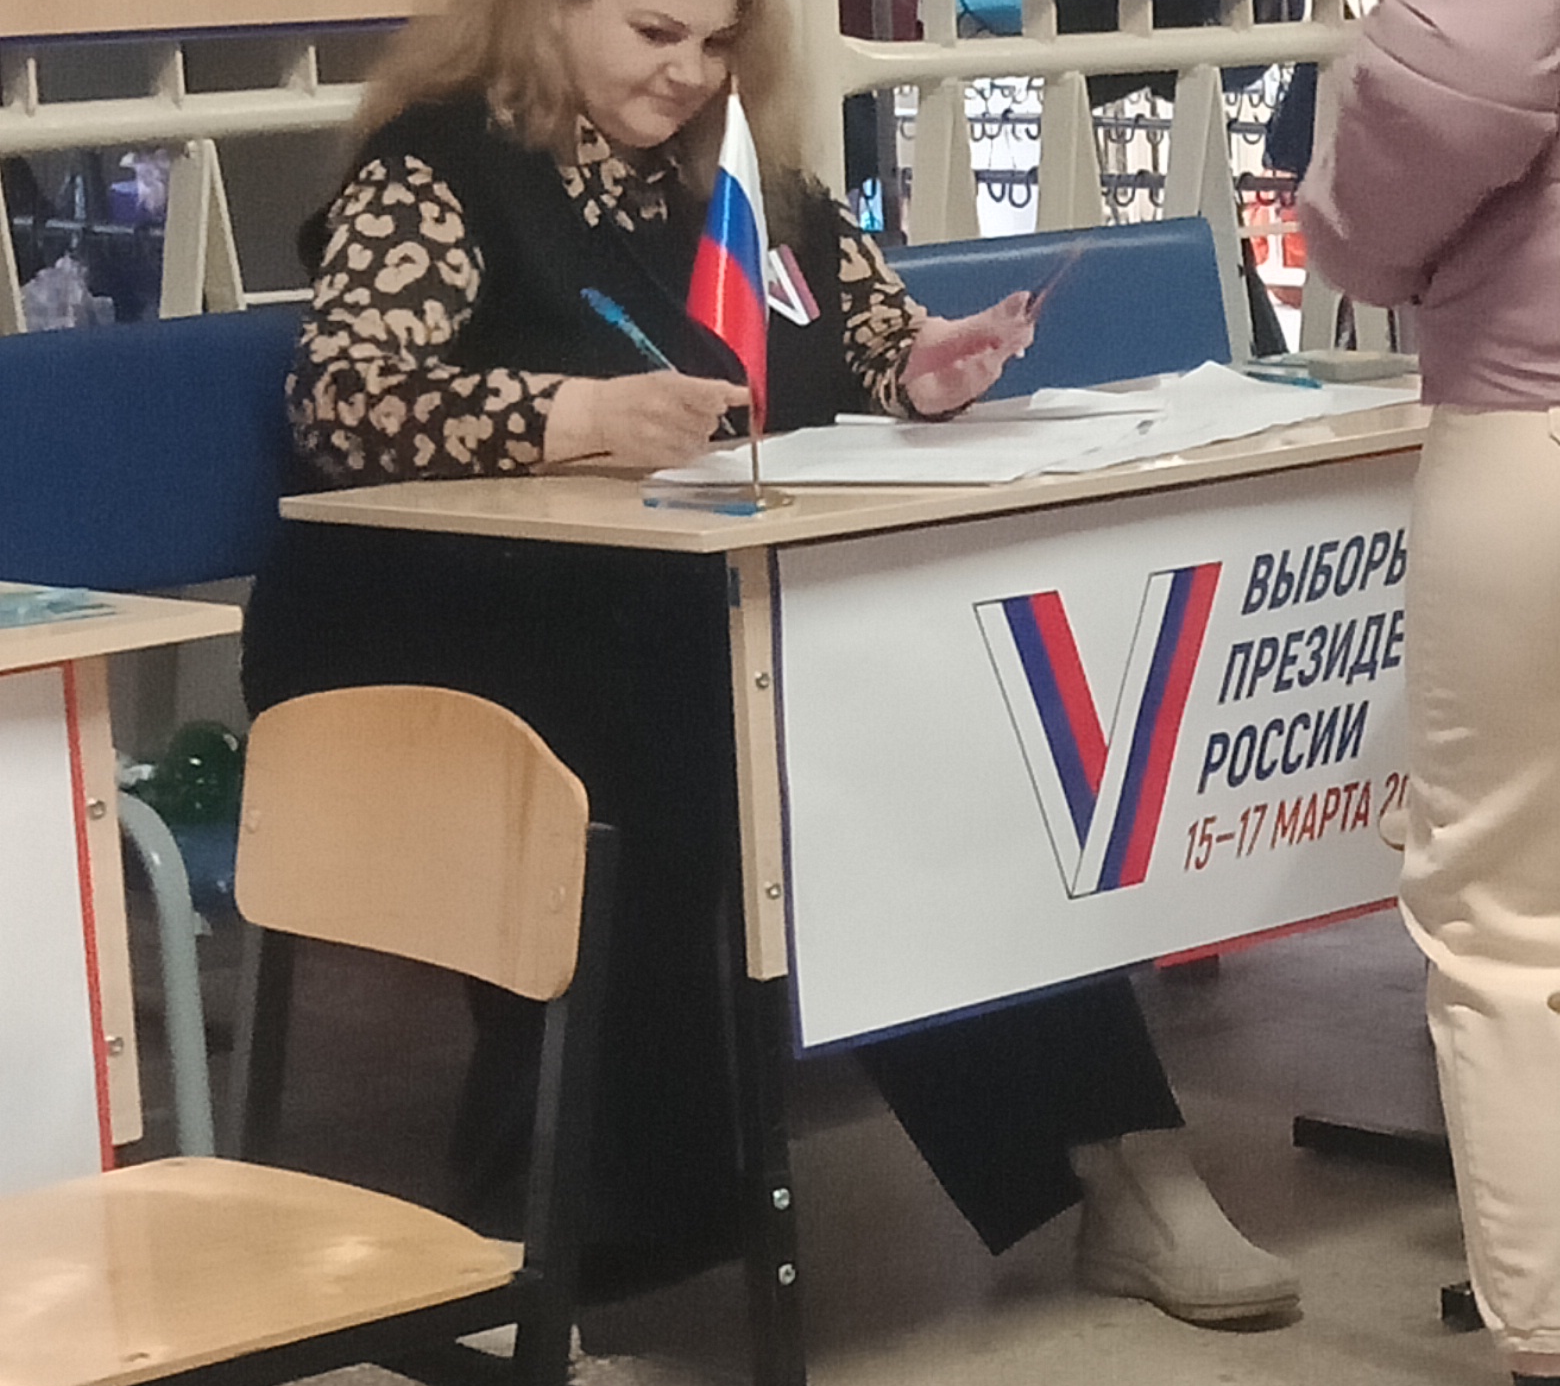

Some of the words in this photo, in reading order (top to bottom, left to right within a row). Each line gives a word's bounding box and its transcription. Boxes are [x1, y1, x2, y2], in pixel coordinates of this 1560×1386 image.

[1217, 609, 1405, 705] ПРЕЗИДЕ
[1197, 700, 1369, 795] РОССИИ
[1270, 780, 1372, 851] МАРТА
